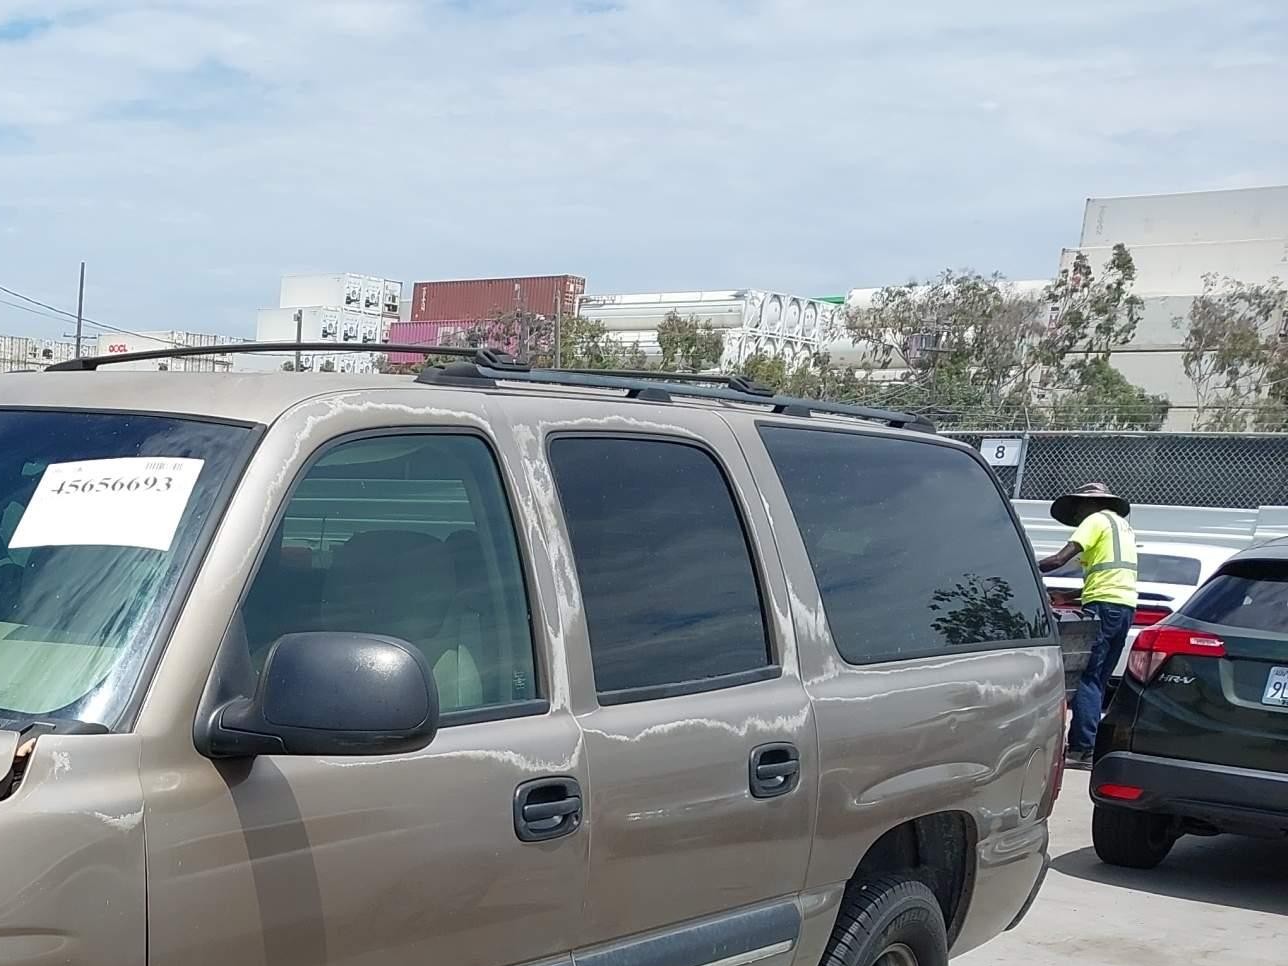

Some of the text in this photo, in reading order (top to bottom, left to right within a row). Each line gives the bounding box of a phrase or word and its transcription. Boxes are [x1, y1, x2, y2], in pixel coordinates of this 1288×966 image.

[108, 343, 128, 353] OOCL
[995, 445, 1006, 459] 8
[51, 476, 173, 494] 45656693
[1158, 673, 1197, 684] HR-V
